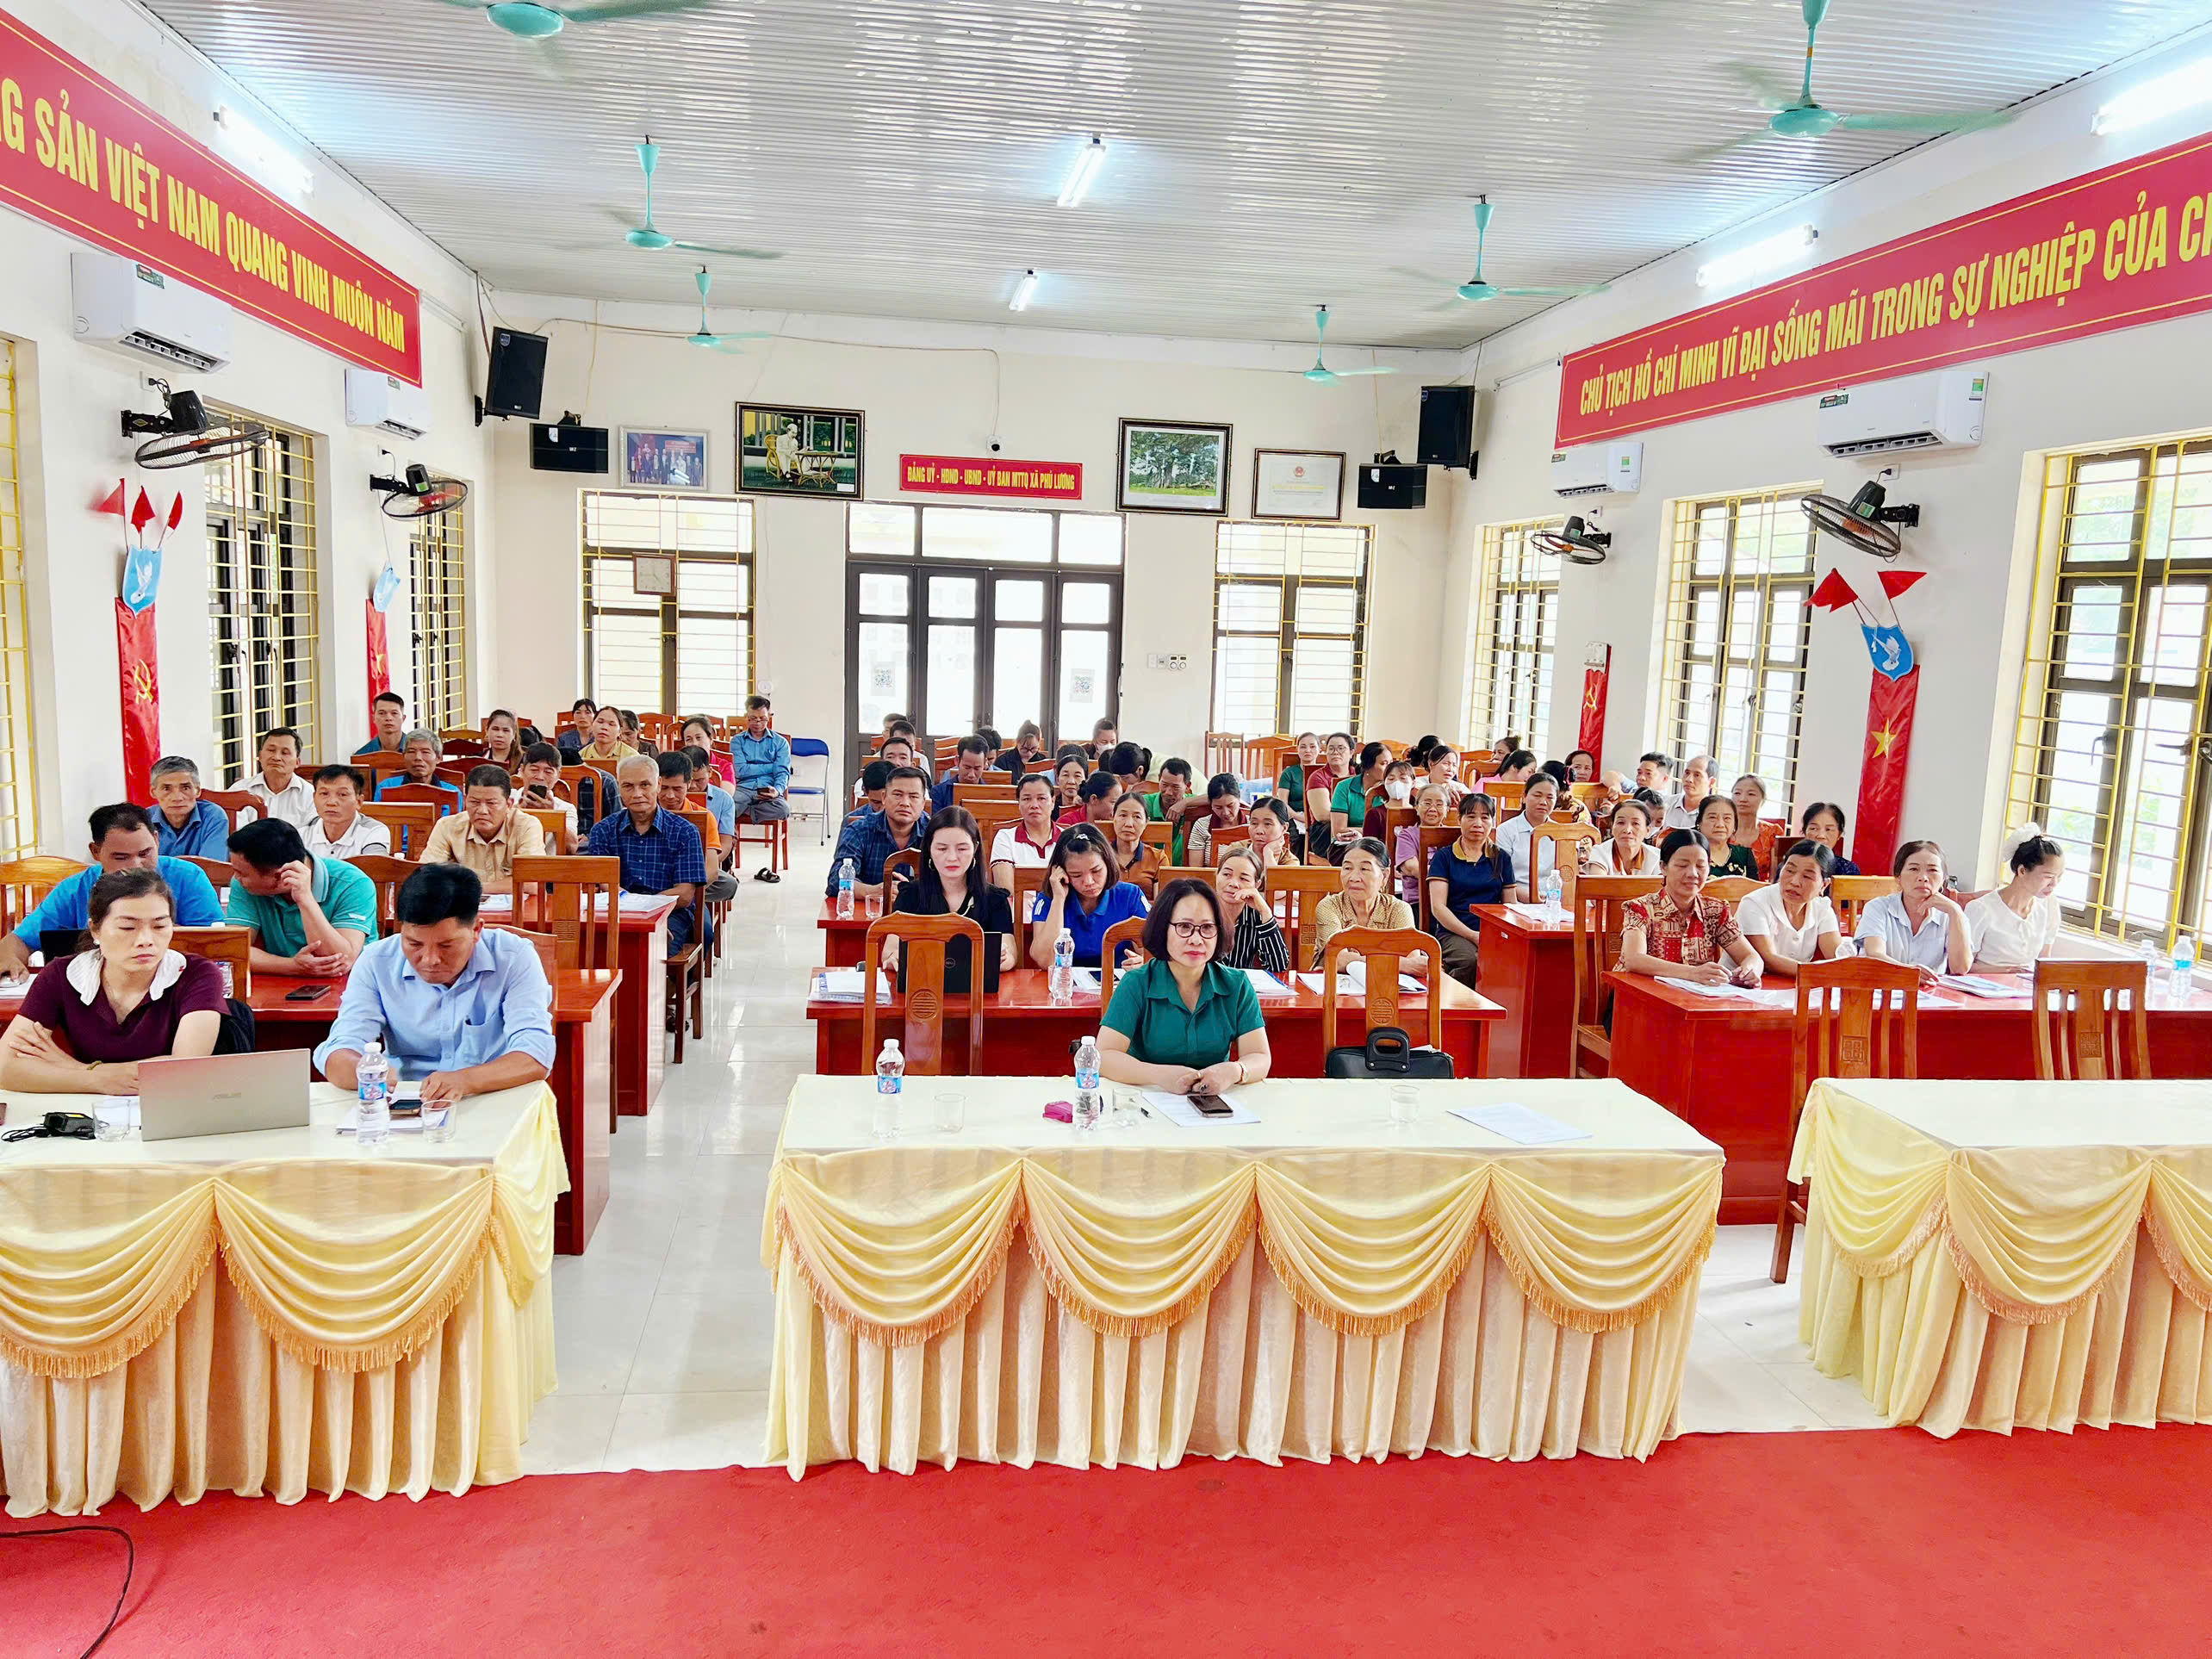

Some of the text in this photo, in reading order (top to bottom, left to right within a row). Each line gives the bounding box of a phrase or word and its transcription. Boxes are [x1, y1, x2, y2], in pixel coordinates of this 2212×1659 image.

[0, 78, 406, 353] G SẢN VIỆT NAM QUANG VINH MUÔN NĂM
[1581, 363, 1604, 415] CHỦ
[1606, 367, 1632, 416] TỊCH
[1633, 348, 1653, 402] HỒ
[1654, 345, 1679, 397] CHÍ
[1679, 340, 1719, 390] MINH
[1722, 326, 1740, 379] VĨ
[1739, 325, 1769, 381] ĐẠI
[1772, 300, 1823, 367] SỐNG
[1825, 288, 1867, 352] MÃI
[1871, 273, 1944, 340] TRONG
[1949, 253, 1990, 328] SỰ
[1989, 221, 2096, 311] NGHIỆP
[2103, 190, 2167, 281] CỦA
[964, 469, 982, 486] UBND
[997, 470, 1010, 488] BAN
[1011, 471, 1029, 489] MTTQ
[1029, 469, 1039, 488] XÃ
[1040, 469, 1053, 489] PHÚ
